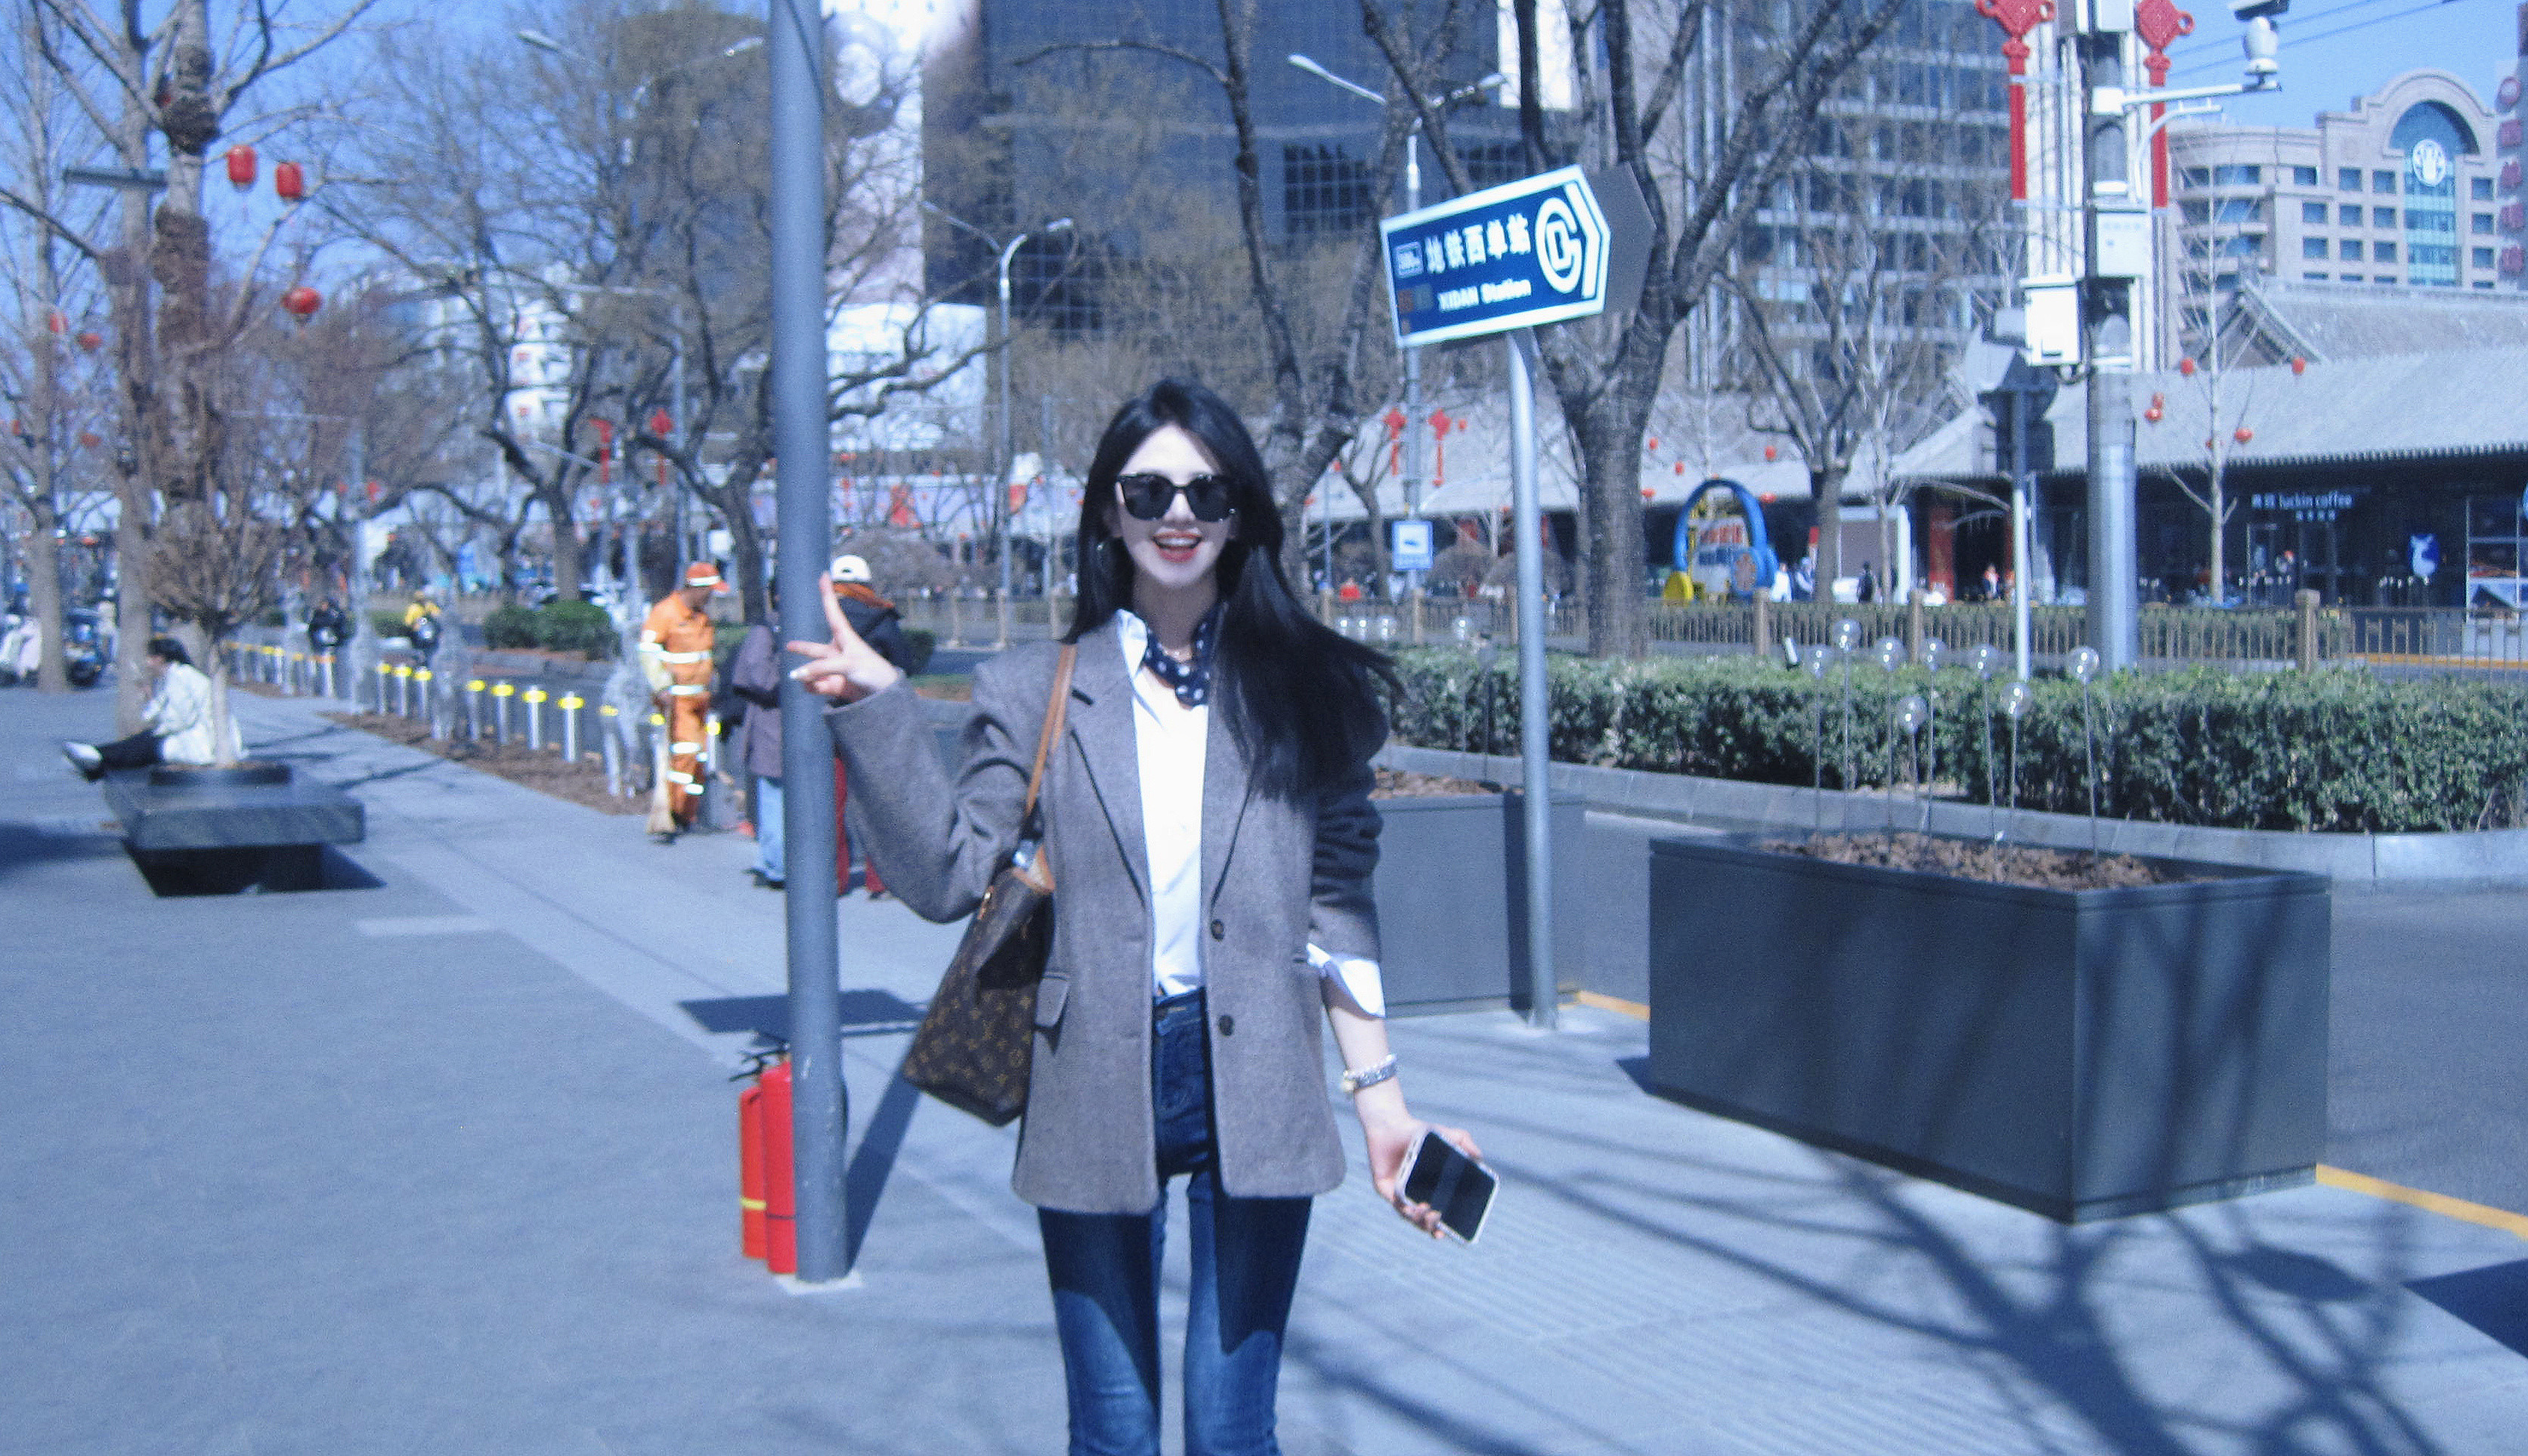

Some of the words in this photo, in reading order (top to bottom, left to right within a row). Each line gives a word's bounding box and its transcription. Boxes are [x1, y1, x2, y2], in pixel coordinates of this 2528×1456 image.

[1425, 213, 1531, 274] 地铁西单站
[1438, 286, 1479, 312] XIDAN
[1481, 278, 1532, 304] Station
